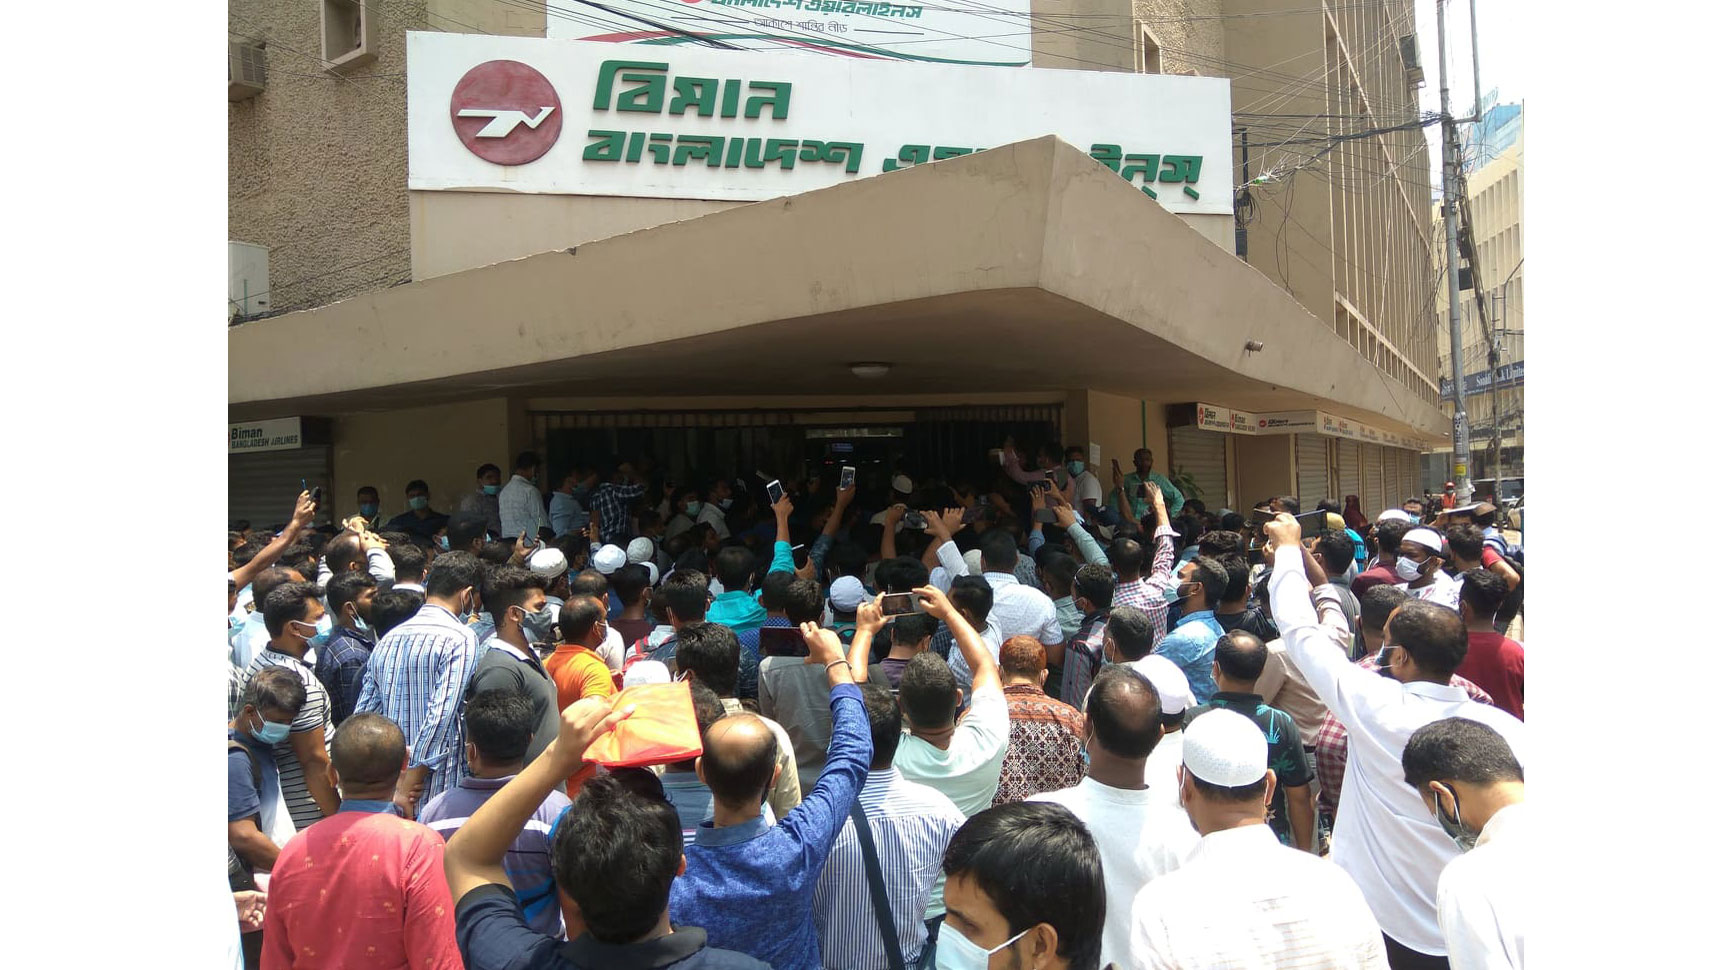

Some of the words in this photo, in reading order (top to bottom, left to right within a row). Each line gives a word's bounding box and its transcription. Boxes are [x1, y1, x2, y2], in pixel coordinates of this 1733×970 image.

[593, 59, 792, 120] বিমান
[582, 129, 865, 174] বাংলাদেশ
[231, 427, 263, 440] Biman
[231, 437, 269, 448] BANGLADESH
[271, 434, 298, 446] AIRLINES
